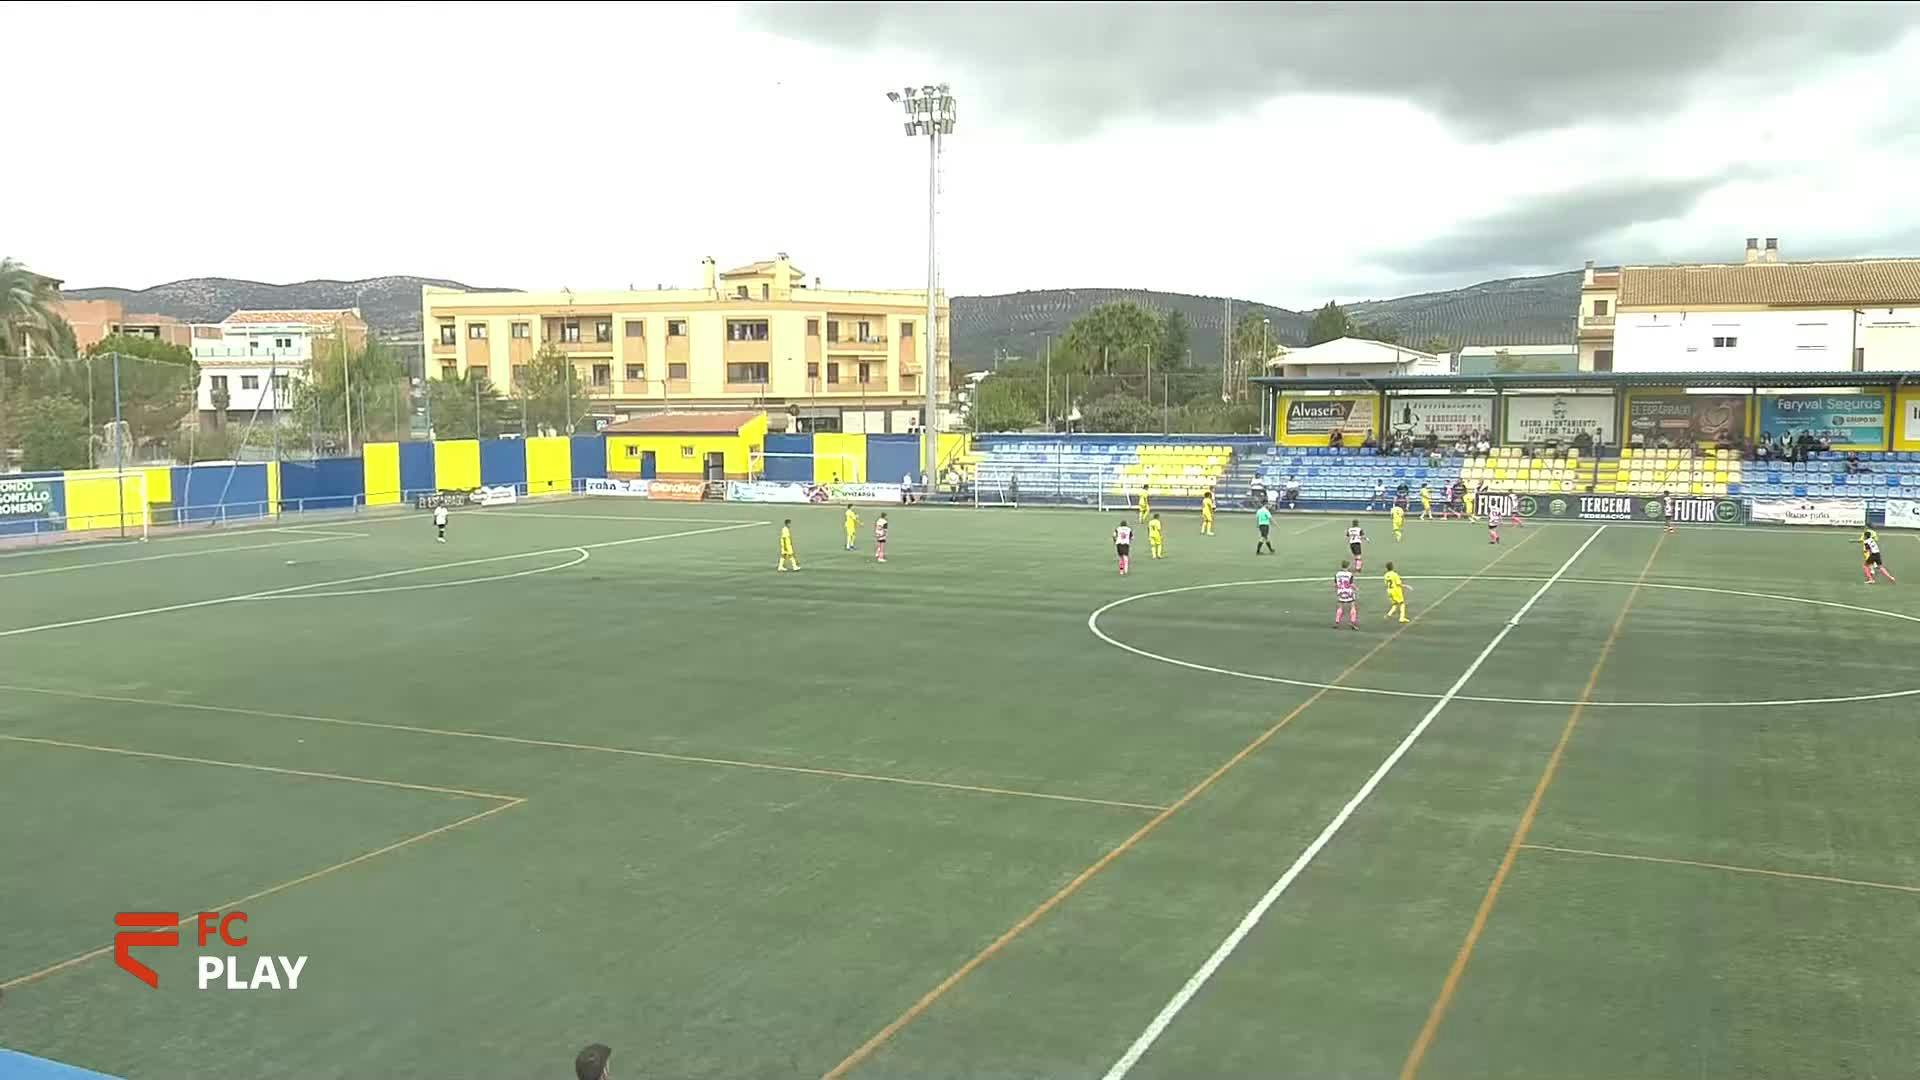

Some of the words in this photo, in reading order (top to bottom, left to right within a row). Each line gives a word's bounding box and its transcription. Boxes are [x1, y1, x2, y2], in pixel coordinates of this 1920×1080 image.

[1778, 400, 1823, 411] Feryval
[1827, 399, 1881, 410] Seguros
[0, 481, 33, 492] ONDO
[1580, 498, 1631, 513] TERCERA
